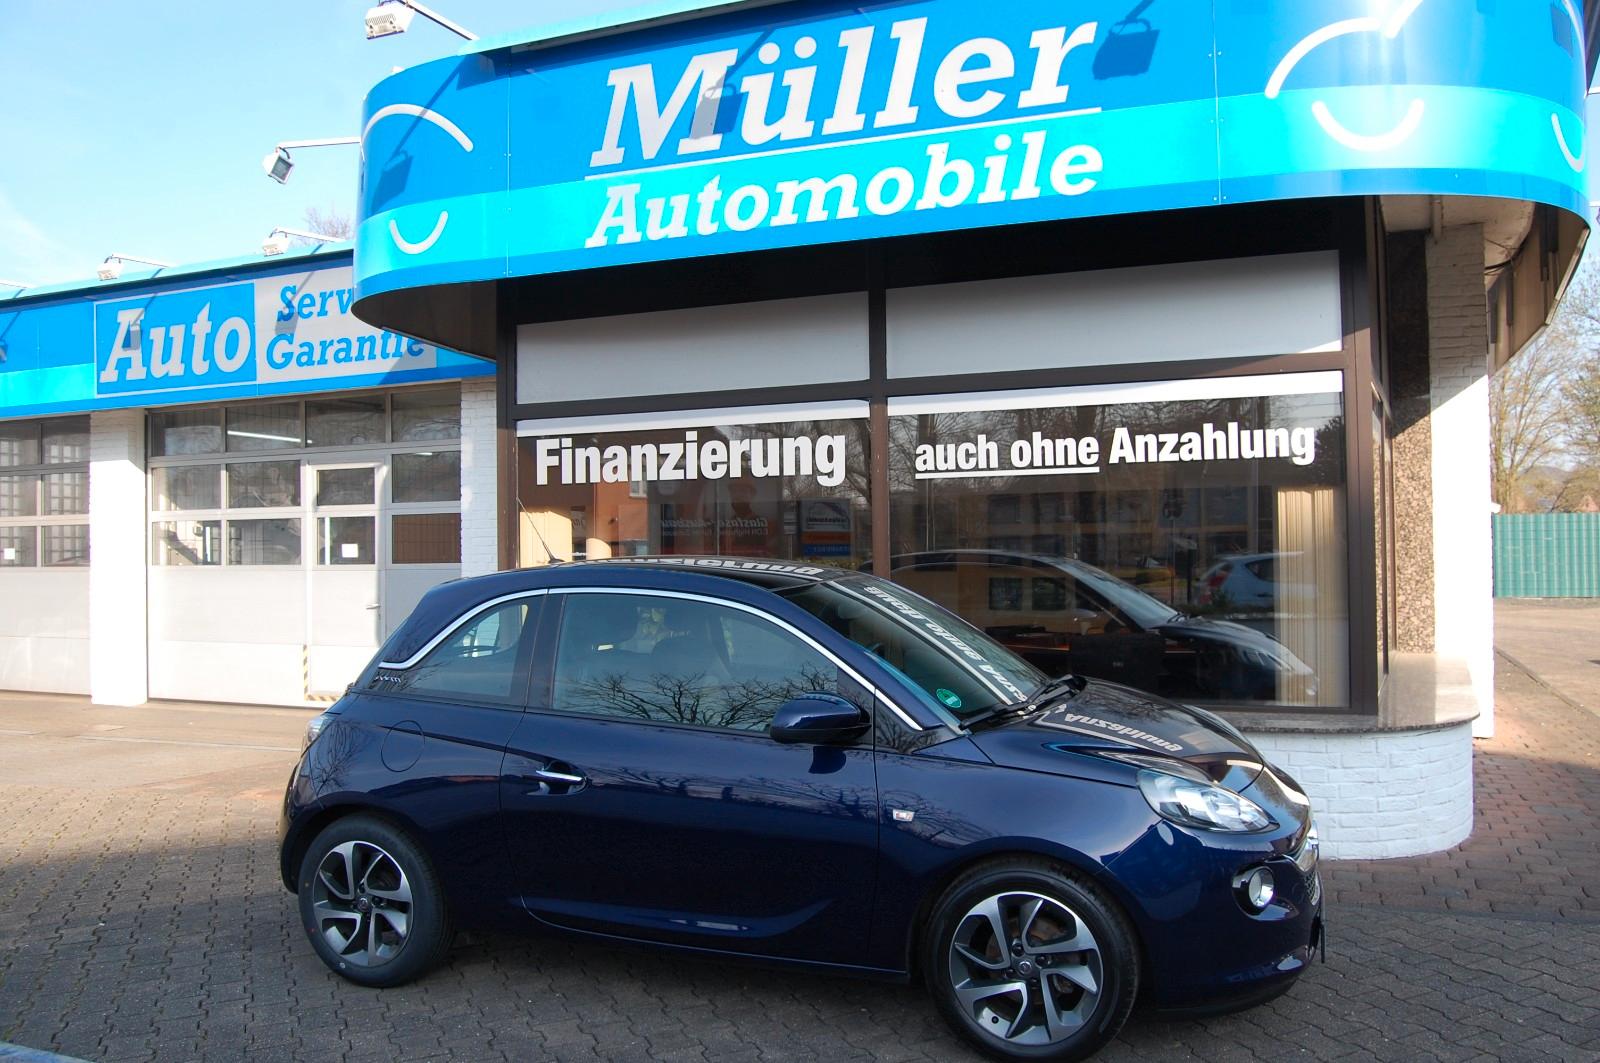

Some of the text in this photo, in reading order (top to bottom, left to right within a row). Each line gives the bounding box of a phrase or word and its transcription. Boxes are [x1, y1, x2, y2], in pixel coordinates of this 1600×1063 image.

[589, 17, 1098, 167] Müller
[584, 130, 1103, 248] Automobile
[99, 301, 251, 384] Auto
[536, 430, 846, 487] Finanzierung
[915, 421, 1316, 472] auch ohne Anzahlung
